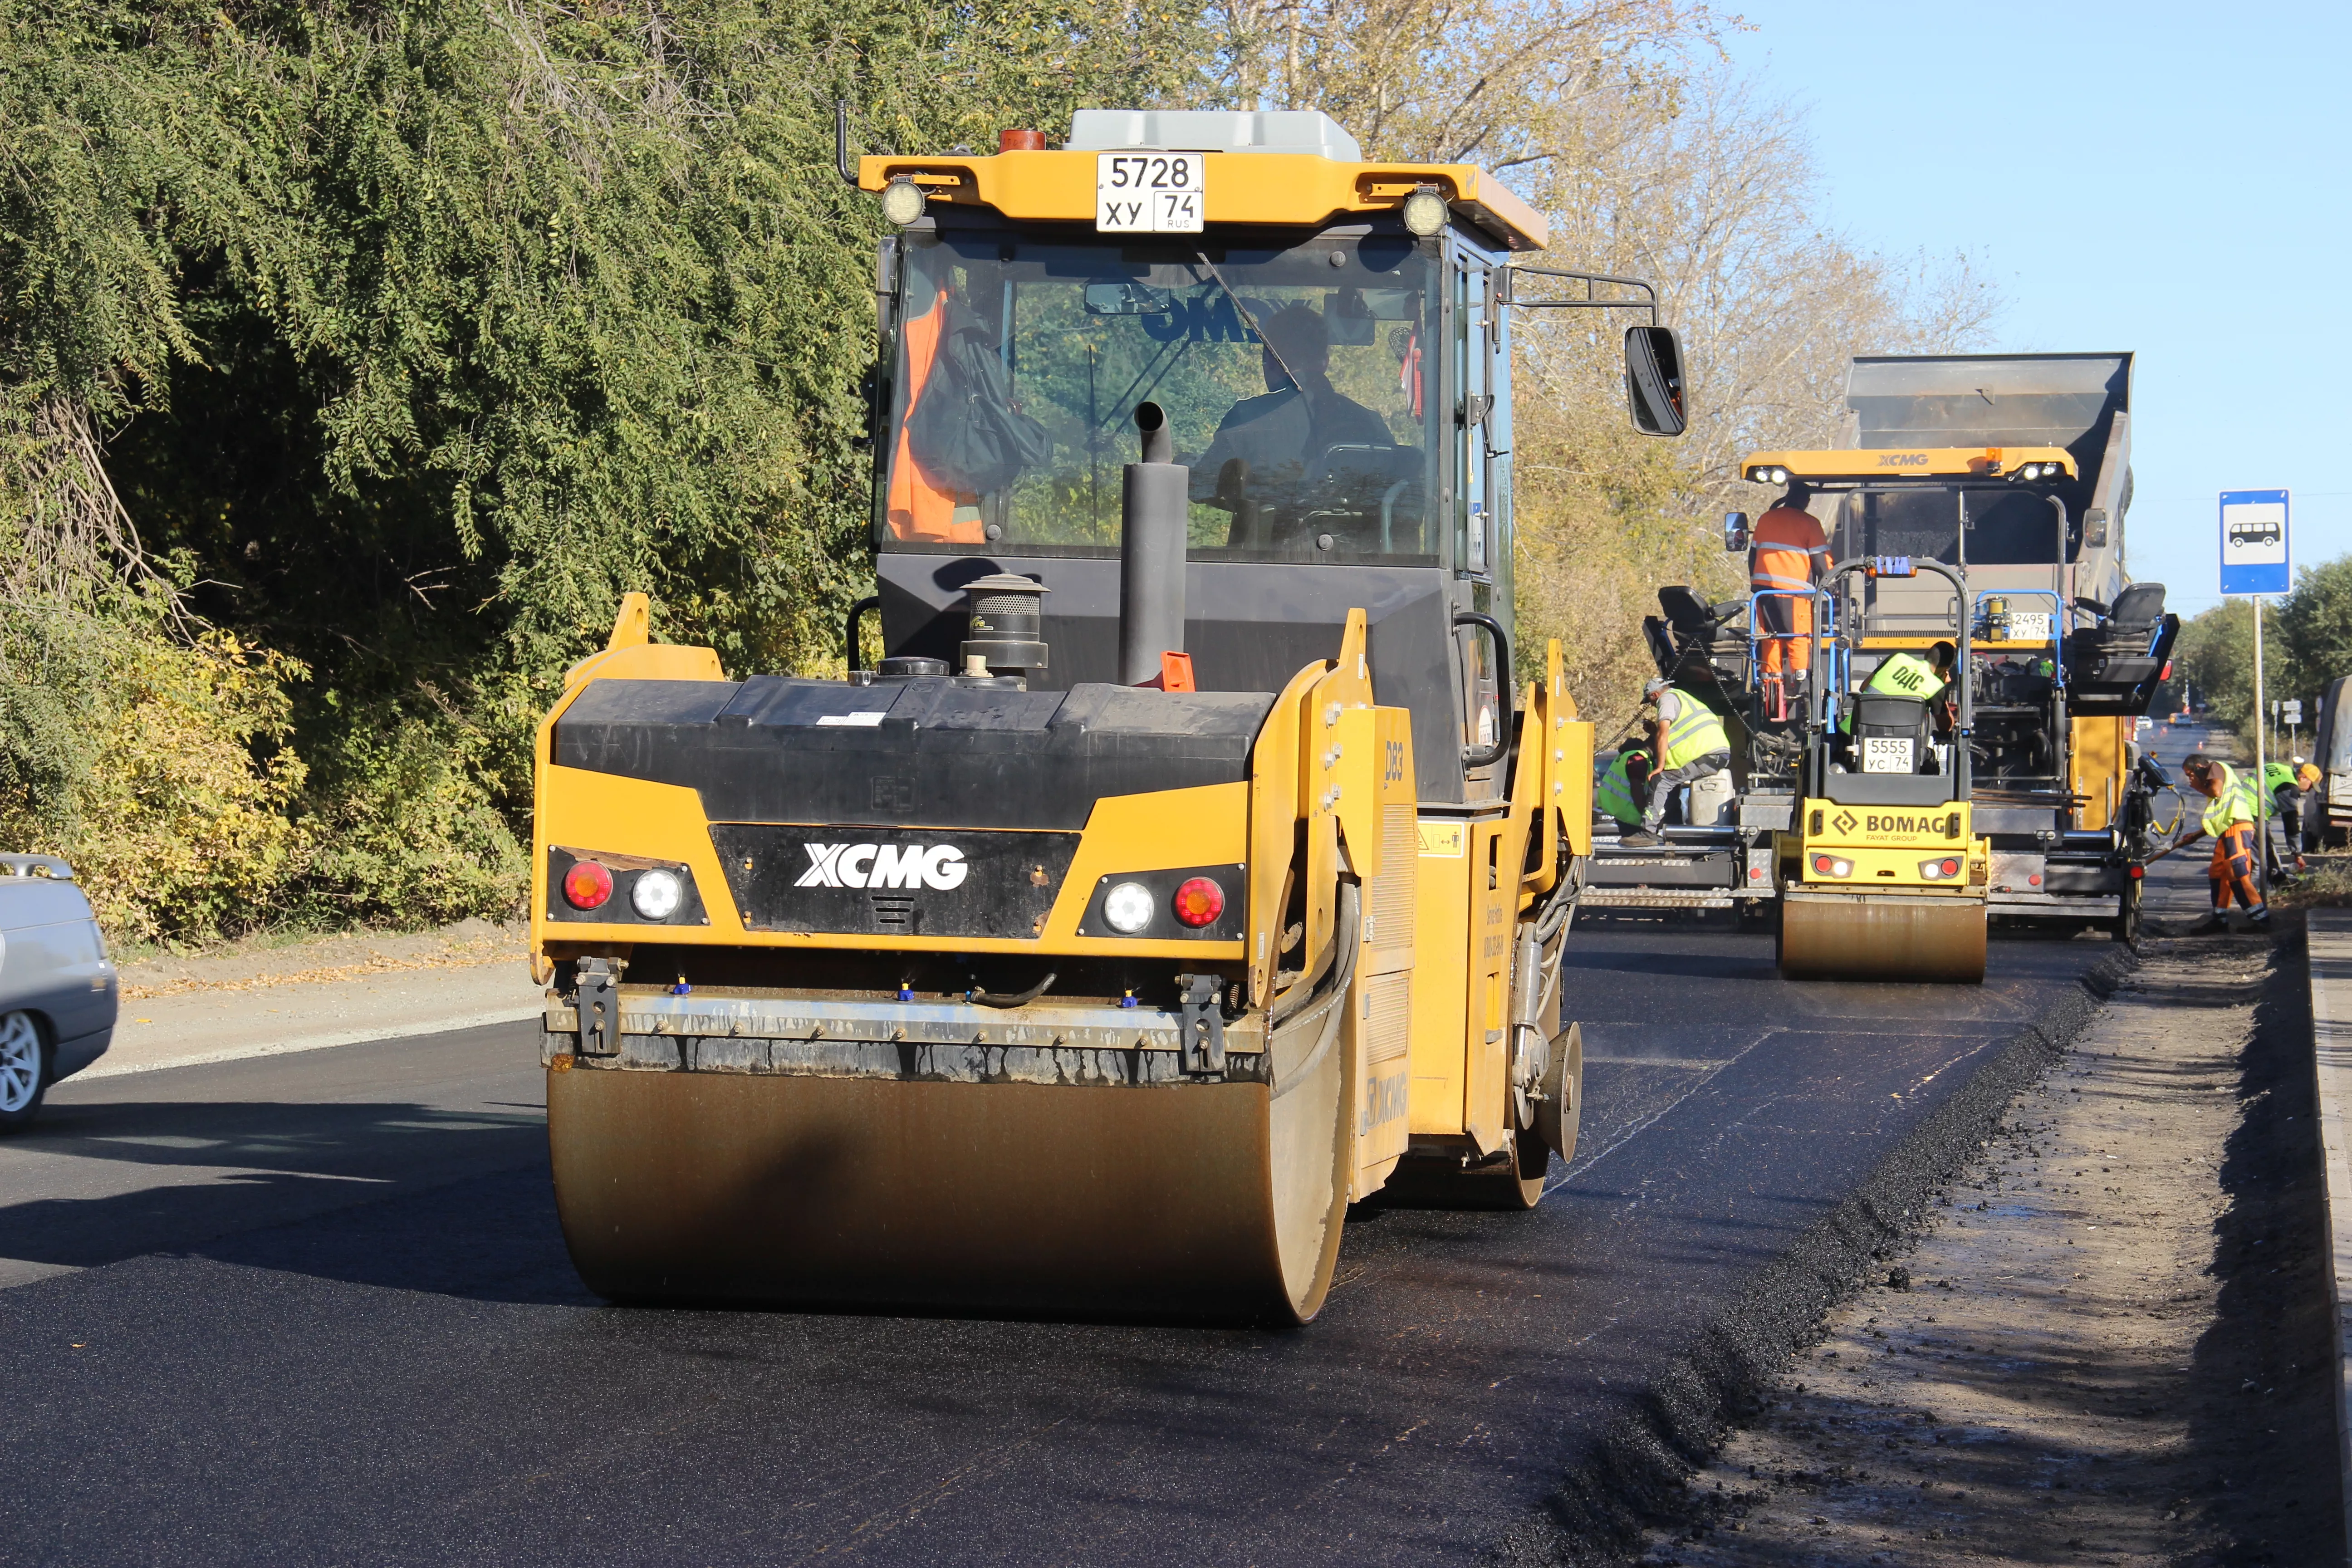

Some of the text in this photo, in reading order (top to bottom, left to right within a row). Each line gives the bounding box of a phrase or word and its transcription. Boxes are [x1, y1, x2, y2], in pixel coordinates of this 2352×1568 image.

[1112, 158, 1189, 187] 5728
[1165, 195, 1193, 218] 74
[1875, 454, 1929, 466] XCMG
[2015, 614, 2044, 625] 2495
[2035, 627, 2045, 635] 74
[1871, 740, 1906, 754] 5555
[1386, 740, 1403, 781] D83
[1895, 757, 1908, 767] 74
[1867, 815, 1945, 833] BOMAG
[793, 843, 968, 890] XCMG
[1376, 1071, 1406, 1125] XCMG
